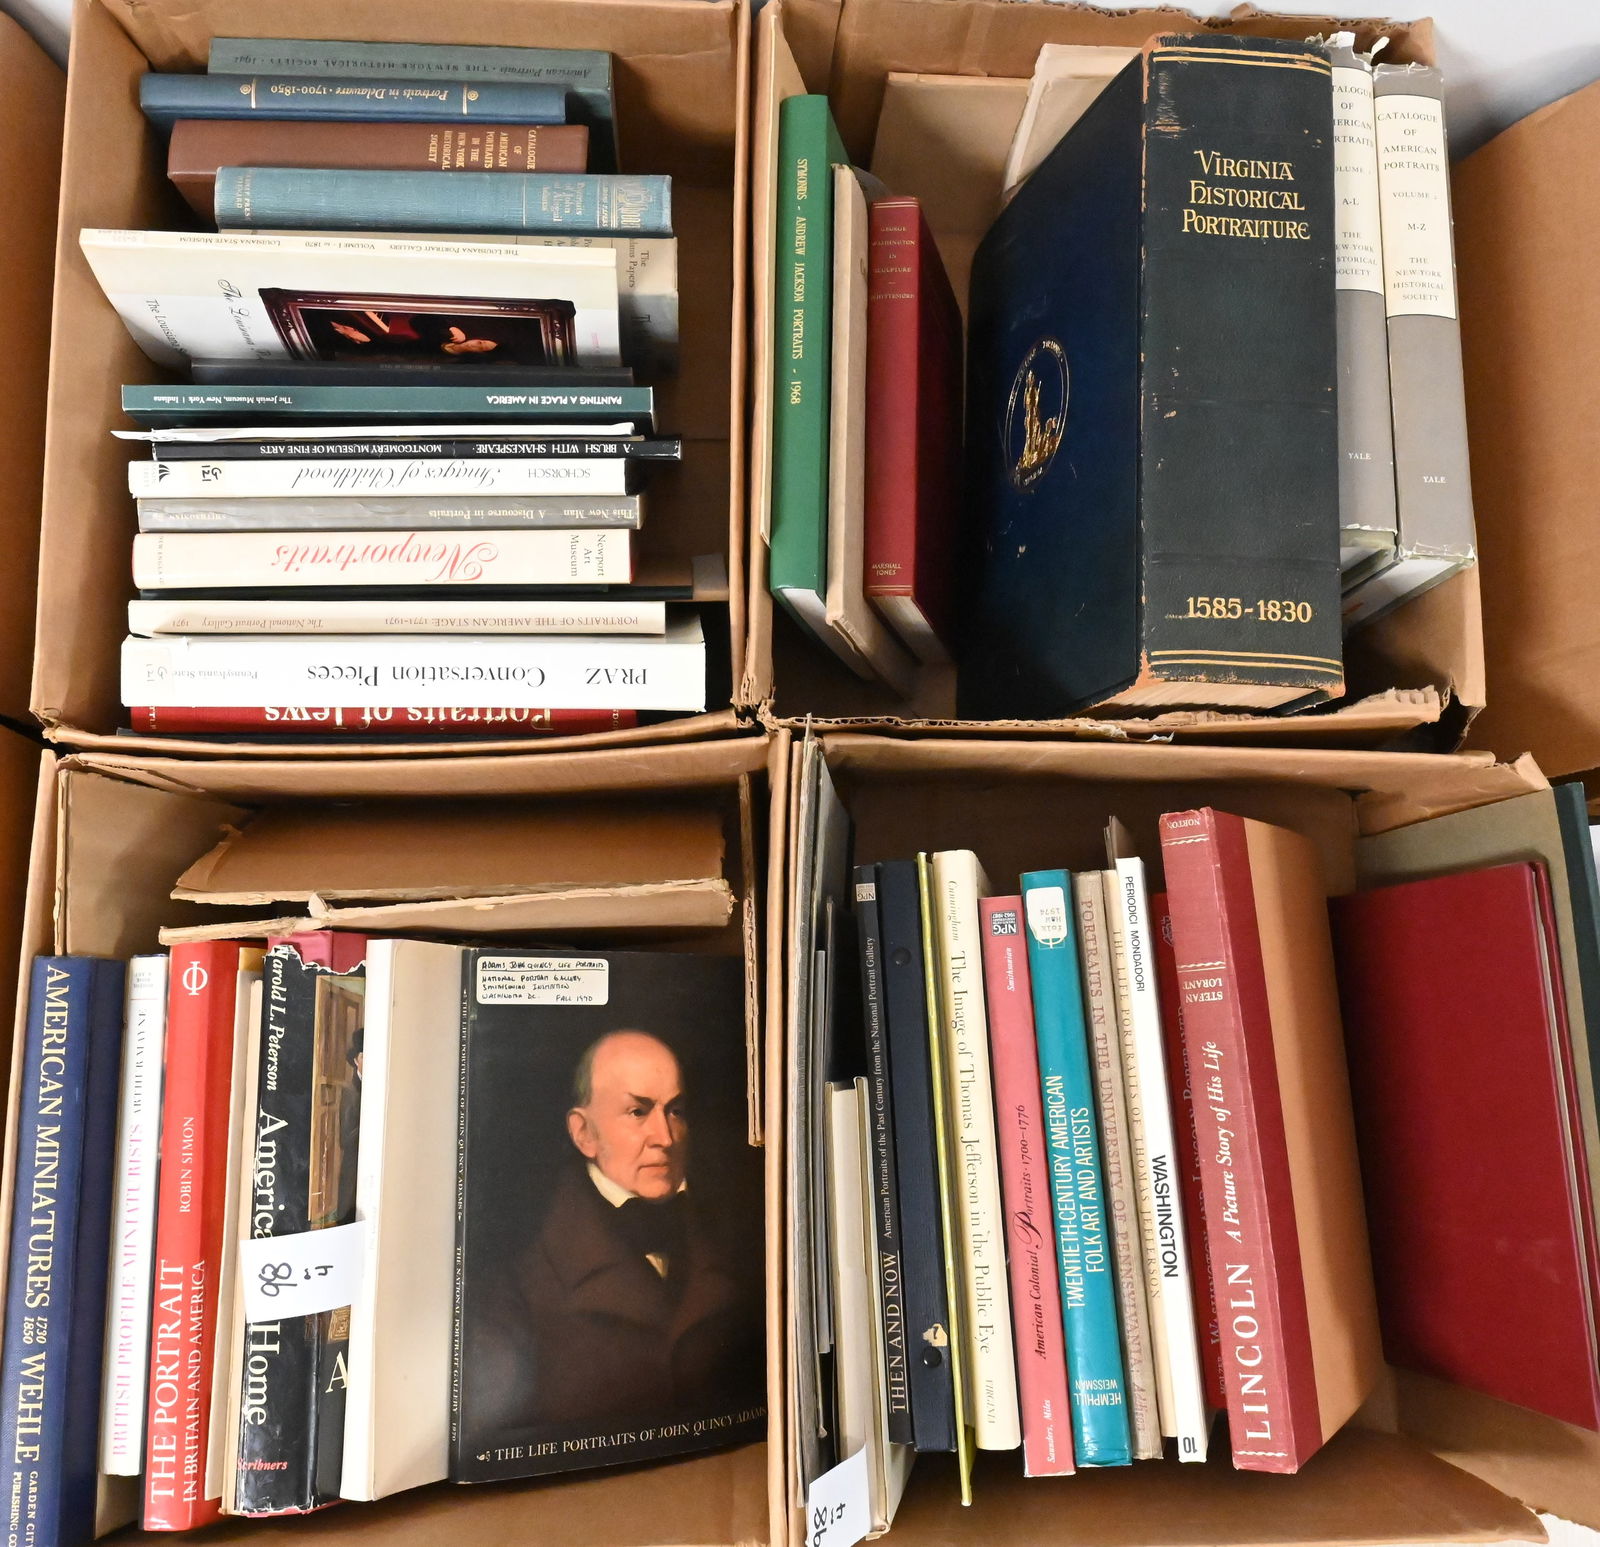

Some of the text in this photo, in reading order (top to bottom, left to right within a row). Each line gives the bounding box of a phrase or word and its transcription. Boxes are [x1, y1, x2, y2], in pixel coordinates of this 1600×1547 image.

[270, 83, 447, 100] Portraits in Delaware 1700-1850
[1377, 112, 1438, 123] CATALOGUE
[428, 133, 439, 164] SOCIETY
[440, 128, 454, 171] HISTORICAL
[483, 130, 496, 170] PORTRAITS
[497, 130, 510, 169] AMERICAN
[526, 128, 538, 171] CATALOGUE
[1383, 145, 1438, 155] AMERICAN
[1194, 151, 1295, 181] VIRGINIA
[1384, 162, 1440, 172] PORTRAITS
[1190, 180, 1305, 211] HISTORICAL
[1182, 208, 1311, 241] PORTRAITURE
[790, 158, 807, 403] SYMONDS ANDREW JACKSON PORTRAITS 1968
[256, 395, 277, 403] Jewish
[486, 395, 526, 403] AMERICA
[541, 396, 567, 404] PLACE
[579, 396, 621, 404] PAINTING
[260, 444, 284, 453] ARTS
[288, 444, 309, 453] FINE
[552, 444, 578, 452] WITH
[585, 443, 616, 452] BRUSH
[623, 444, 630, 452] A
[291, 460, 500, 488] Images of Childhood
[528, 468, 589, 477] SCHORSCH
[428, 510, 544, 519] A Discourse in Portraits
[564, 507, 637, 521] This New Man
[271, 533, 499, 583] Newportraits
[570, 535, 578, 576] Museum
[595, 534, 605, 575] Newport
[385, 615, 642, 626] PORTRAITS OF THE AMERICAN STAGE: 1771-1971
[1186, 596, 1312, 624] 1585-1830
[308, 666, 544, 685] Conversation Pieces
[586, 668, 645, 683] PRAZ
[1125, 876, 1144, 991] PERIODICI MONDADORI
[866, 937, 874, 966] Gallery
[868, 969, 876, 999] Portrait
[1182, 978, 1223, 991] LORANT
[1184, 990, 1223, 1003] STEFAN
[266, 944, 292, 1089] Harold L. Peterson
[869, 1003, 878, 1036] National
[875, 1078, 883, 1110] Century
[25, 964, 69, 1307] AMERICAN MINIATURES
[1081, 899, 1142, 1374] PORTRAITS IN THE UNIVERSITY OF PENNSYLVANIA:
[1202, 1041, 1241, 1242] A Picture Story of His Life
[179, 1117, 193, 1211] ROBIN SIMON
[878, 1148, 885, 1156] of
[950, 950, 995, 1354] The Image of Thomas Jefferson in the Public Eye
[1045, 1075, 1087, 1308] TWENTIETH-CENTURY AMERICAN
[1070, 1107, 1103, 1272] FOLK ART AND ARTISTS
[883, 1197, 891, 1237] American
[1012, 1171, 1043, 1250] Portraits
[1152, 1155, 1177, 1276] WASHINGTON
[112, 1121, 141, 1454] BRITISH PROFILE MINIATURISTS
[1025, 1249, 1042, 1300] Colonial
[22, 1315, 36, 1344] 1850
[35, 1315, 49, 1344] 1730
[883, 1251, 906, 1412] THEN AND NOW
[1030, 1303, 1046, 1360] American
[1226, 1263, 1270, 1439] LINCOLN
[151, 1256, 183, 1503] THE PORTRAIT
[183, 1258, 206, 1506] IN BRITAIN AND AMERICA
[14, 1351, 47, 1463] WEHLE
[495, 1407, 767, 1461] THE LIFE PORTRAITS OF JOHN QUINCY ADAMS
[1181, 1437, 1196, 1454] 10
[8, 1471, 23, 1530] PUBLISHING
[27, 1471, 37, 1518] GARDEN
